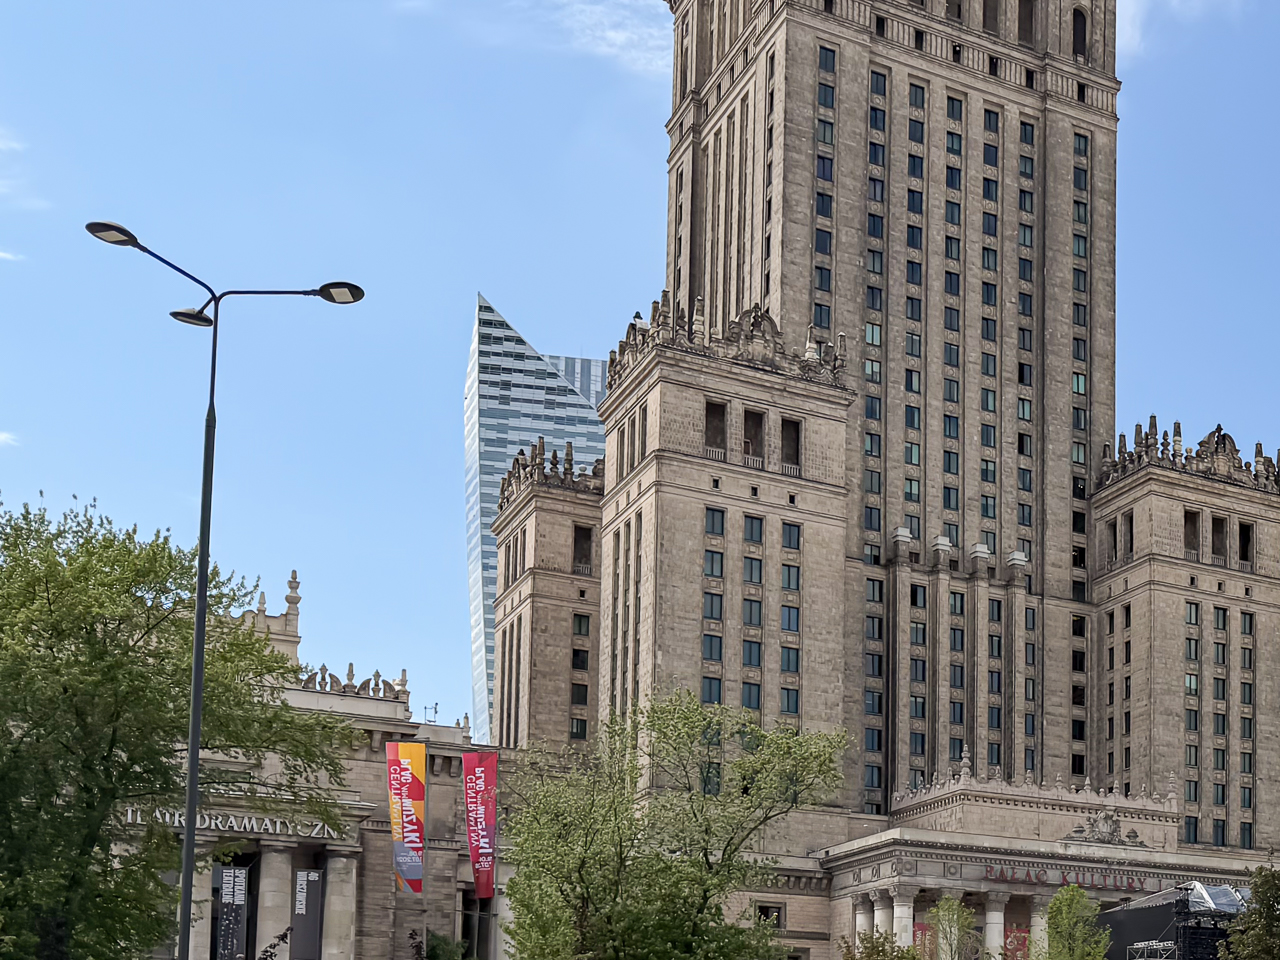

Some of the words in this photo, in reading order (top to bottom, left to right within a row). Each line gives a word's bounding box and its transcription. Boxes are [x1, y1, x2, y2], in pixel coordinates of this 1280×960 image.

[196, 813, 351, 840] DRAMATYCZN
[221, 868, 234, 904] TEATRALNE
[295, 871, 308, 915] WARSZAWSKIE
[1061, 871, 1147, 892] KULTURY
